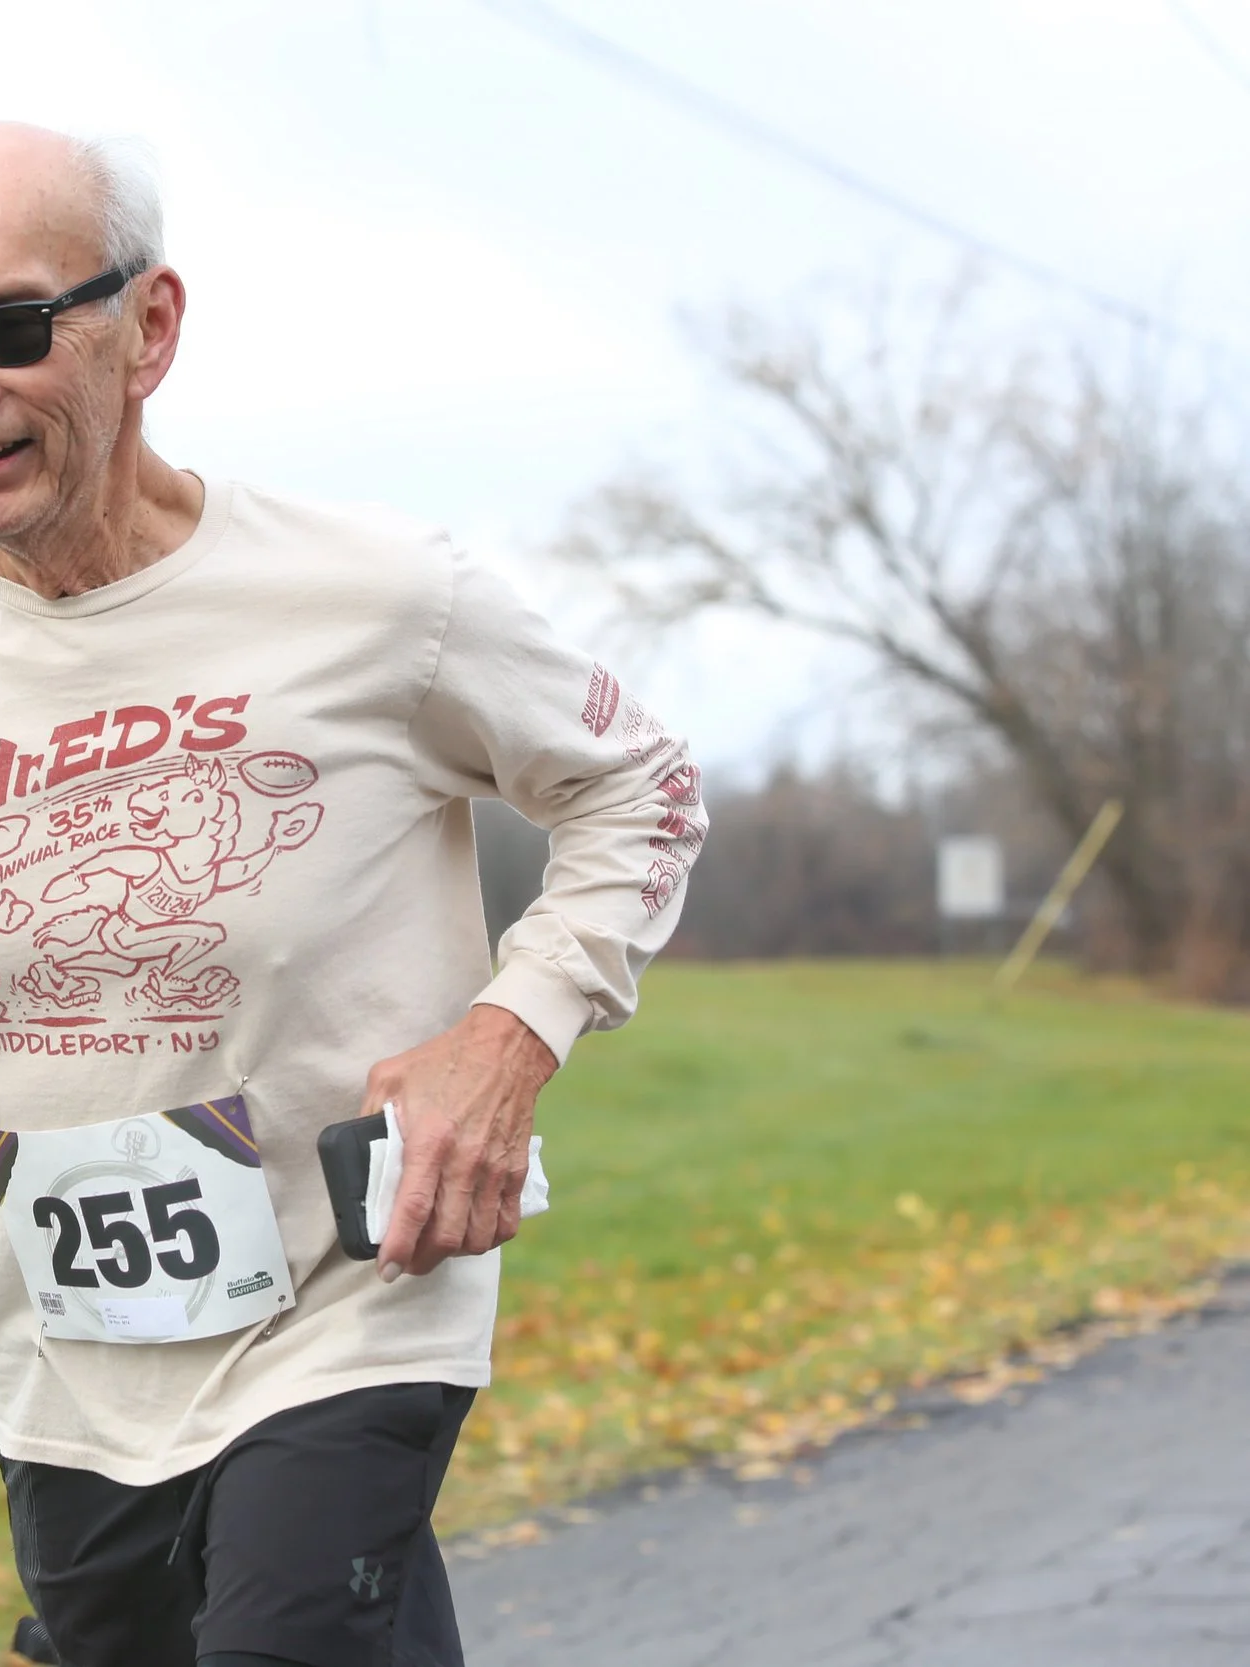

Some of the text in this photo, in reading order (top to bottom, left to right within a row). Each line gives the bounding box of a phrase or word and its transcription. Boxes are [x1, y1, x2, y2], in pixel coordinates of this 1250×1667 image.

[581, 671, 601, 732] SUNRISE
[47, 795, 112, 837] 35th
[67, 823, 121, 851] RACE
[648, 837, 690, 872] MIDDLEPO
[170, 1031, 220, 1053] NY
[32, 1177, 221, 1289] 255
[227, 1276, 255, 1288] Buffalo
[228, 1279, 272, 1298] BARRIERS
